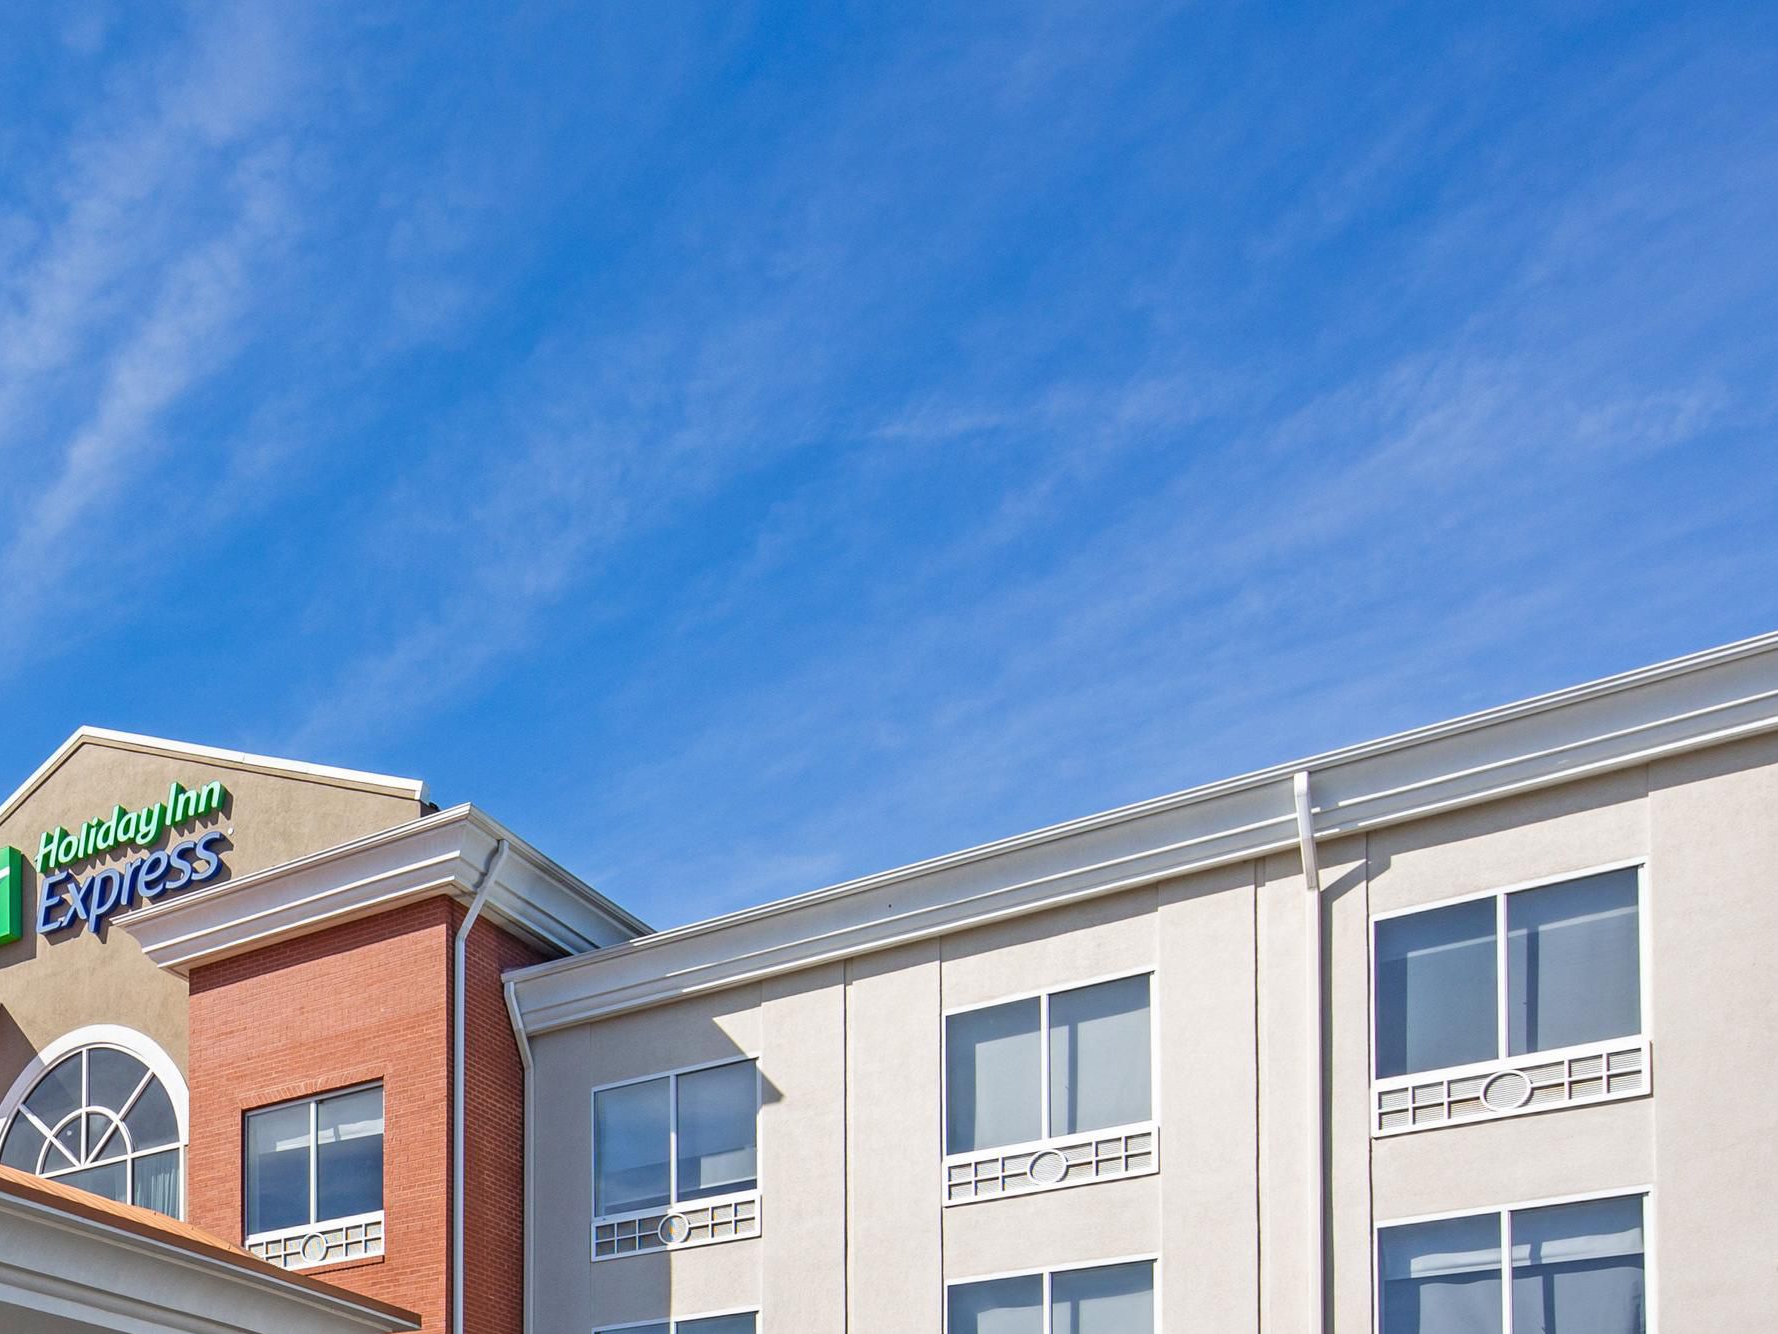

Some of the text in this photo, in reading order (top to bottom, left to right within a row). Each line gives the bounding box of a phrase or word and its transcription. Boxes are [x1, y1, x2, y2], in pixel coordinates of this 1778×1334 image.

[34, 779, 224, 873] Holiday Inn
[36, 831, 223, 934] Express
